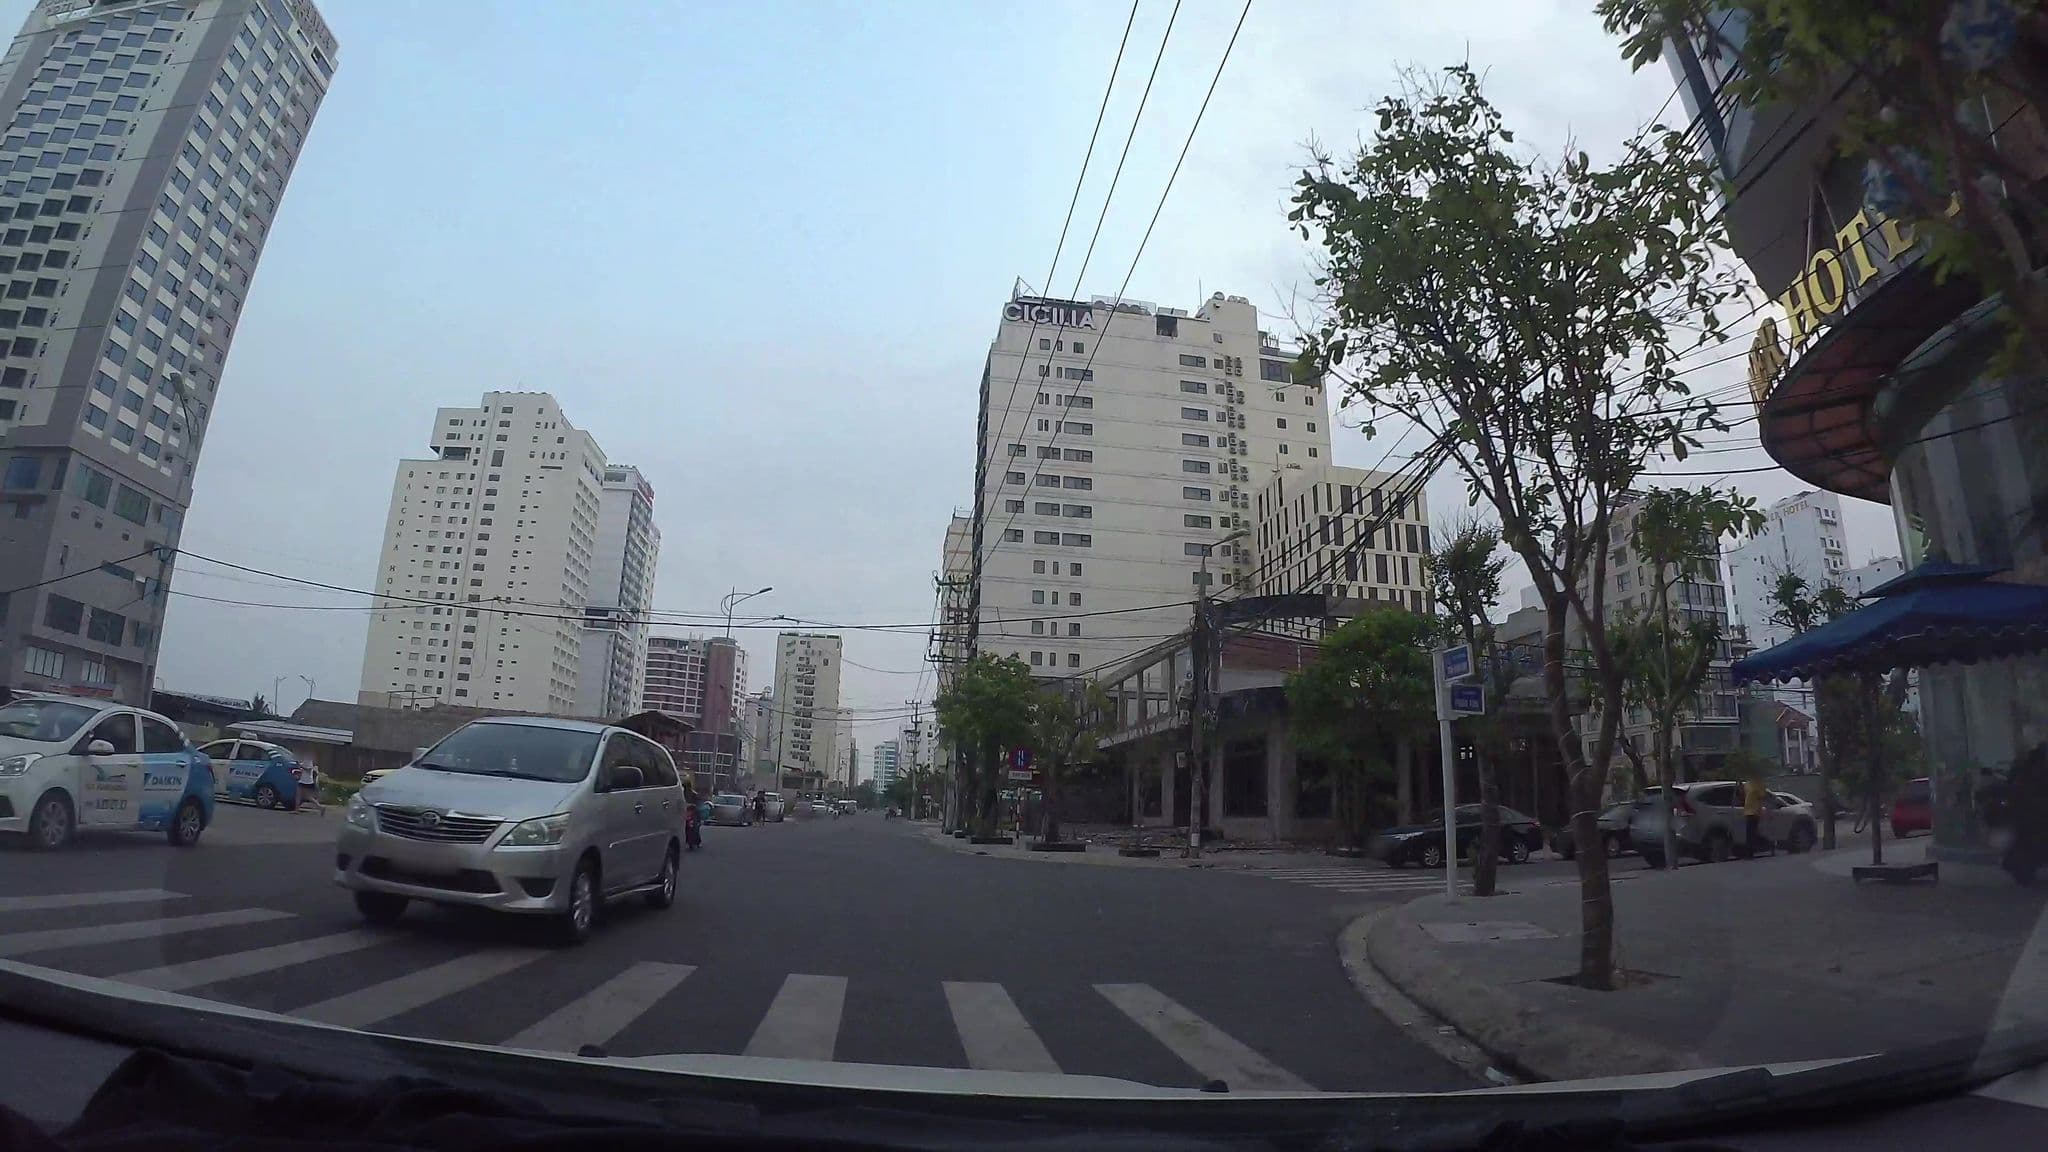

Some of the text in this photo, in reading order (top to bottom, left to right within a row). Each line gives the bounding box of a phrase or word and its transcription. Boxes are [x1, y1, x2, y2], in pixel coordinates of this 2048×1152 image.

[1779, 191, 1961, 350] HOTE
[1003, 303, 1097, 330] CICILIA
[1784, 500, 1809, 517] HOTEL
[382, 565, 396, 622] HOTEL
[152, 775, 182, 785] DAIKIN
